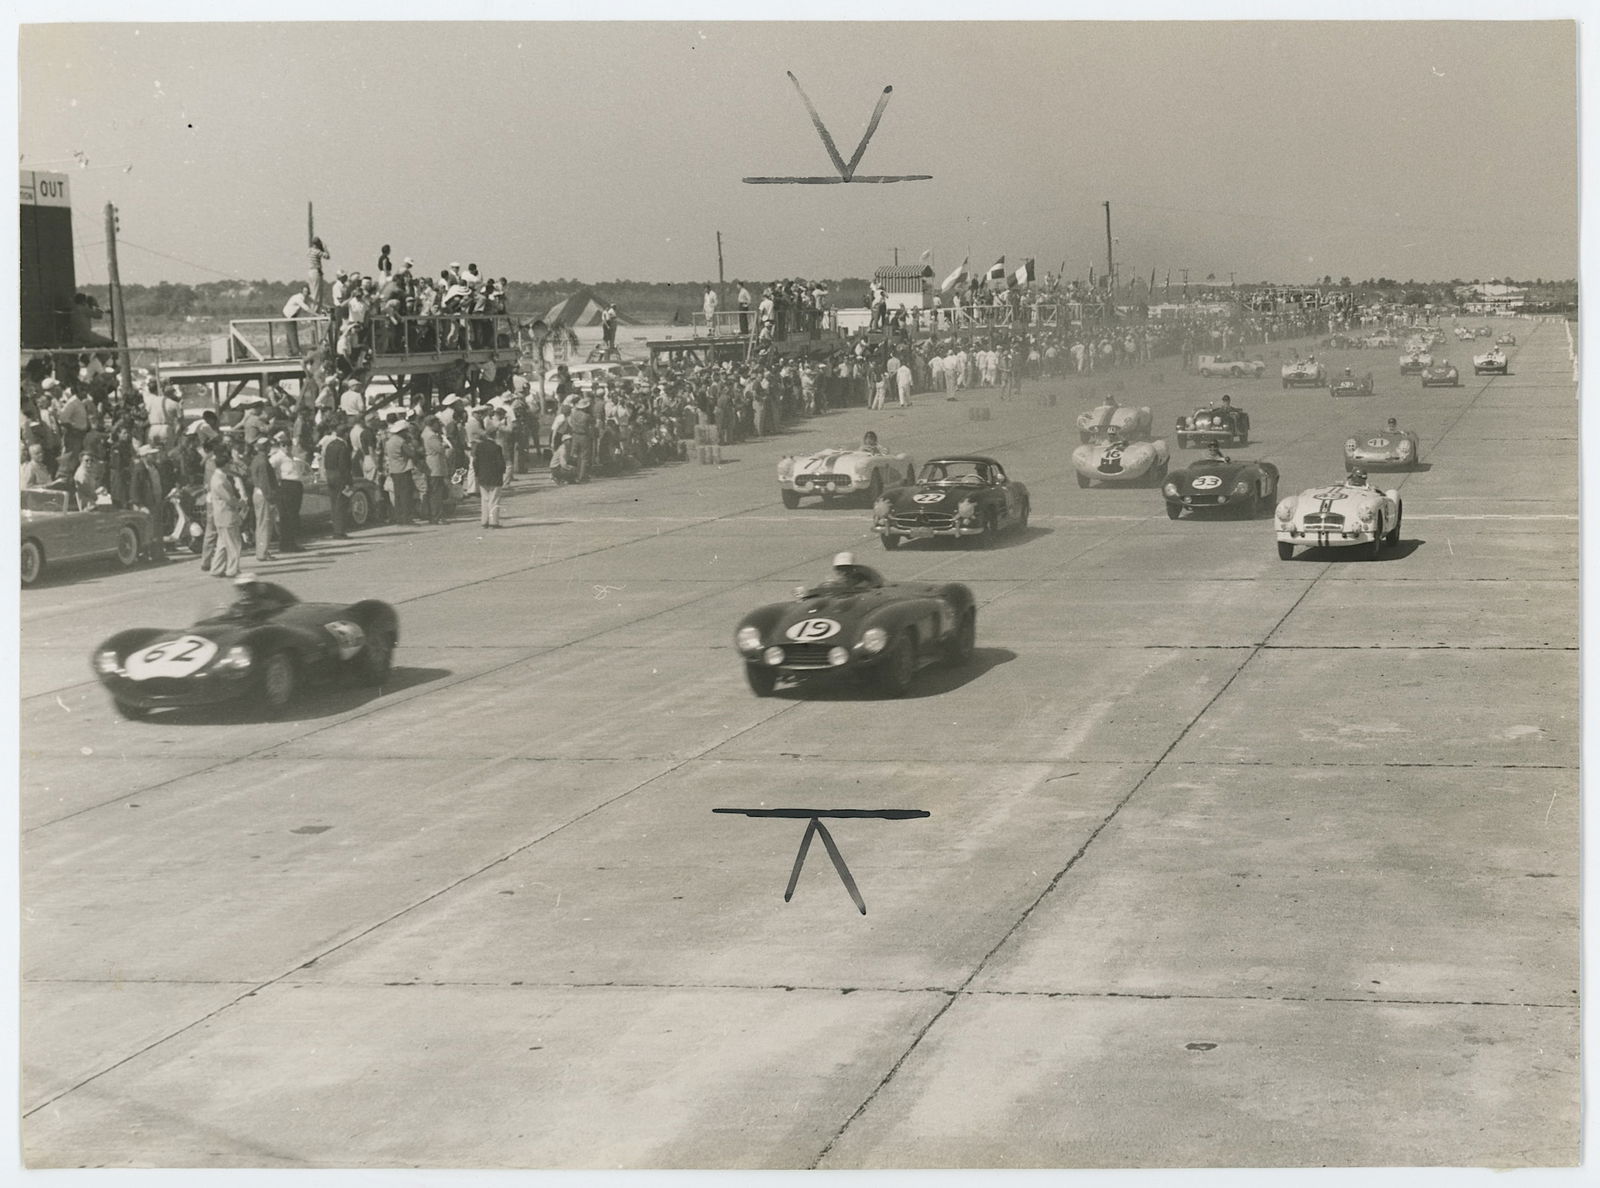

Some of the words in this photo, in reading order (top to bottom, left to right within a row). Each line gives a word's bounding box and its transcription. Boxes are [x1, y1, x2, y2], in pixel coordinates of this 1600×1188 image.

[40, 180, 63, 198] OUT
[1193, 477, 1220, 487] 33
[797, 621, 831, 638] 19
[143, 639, 205, 664] 62
